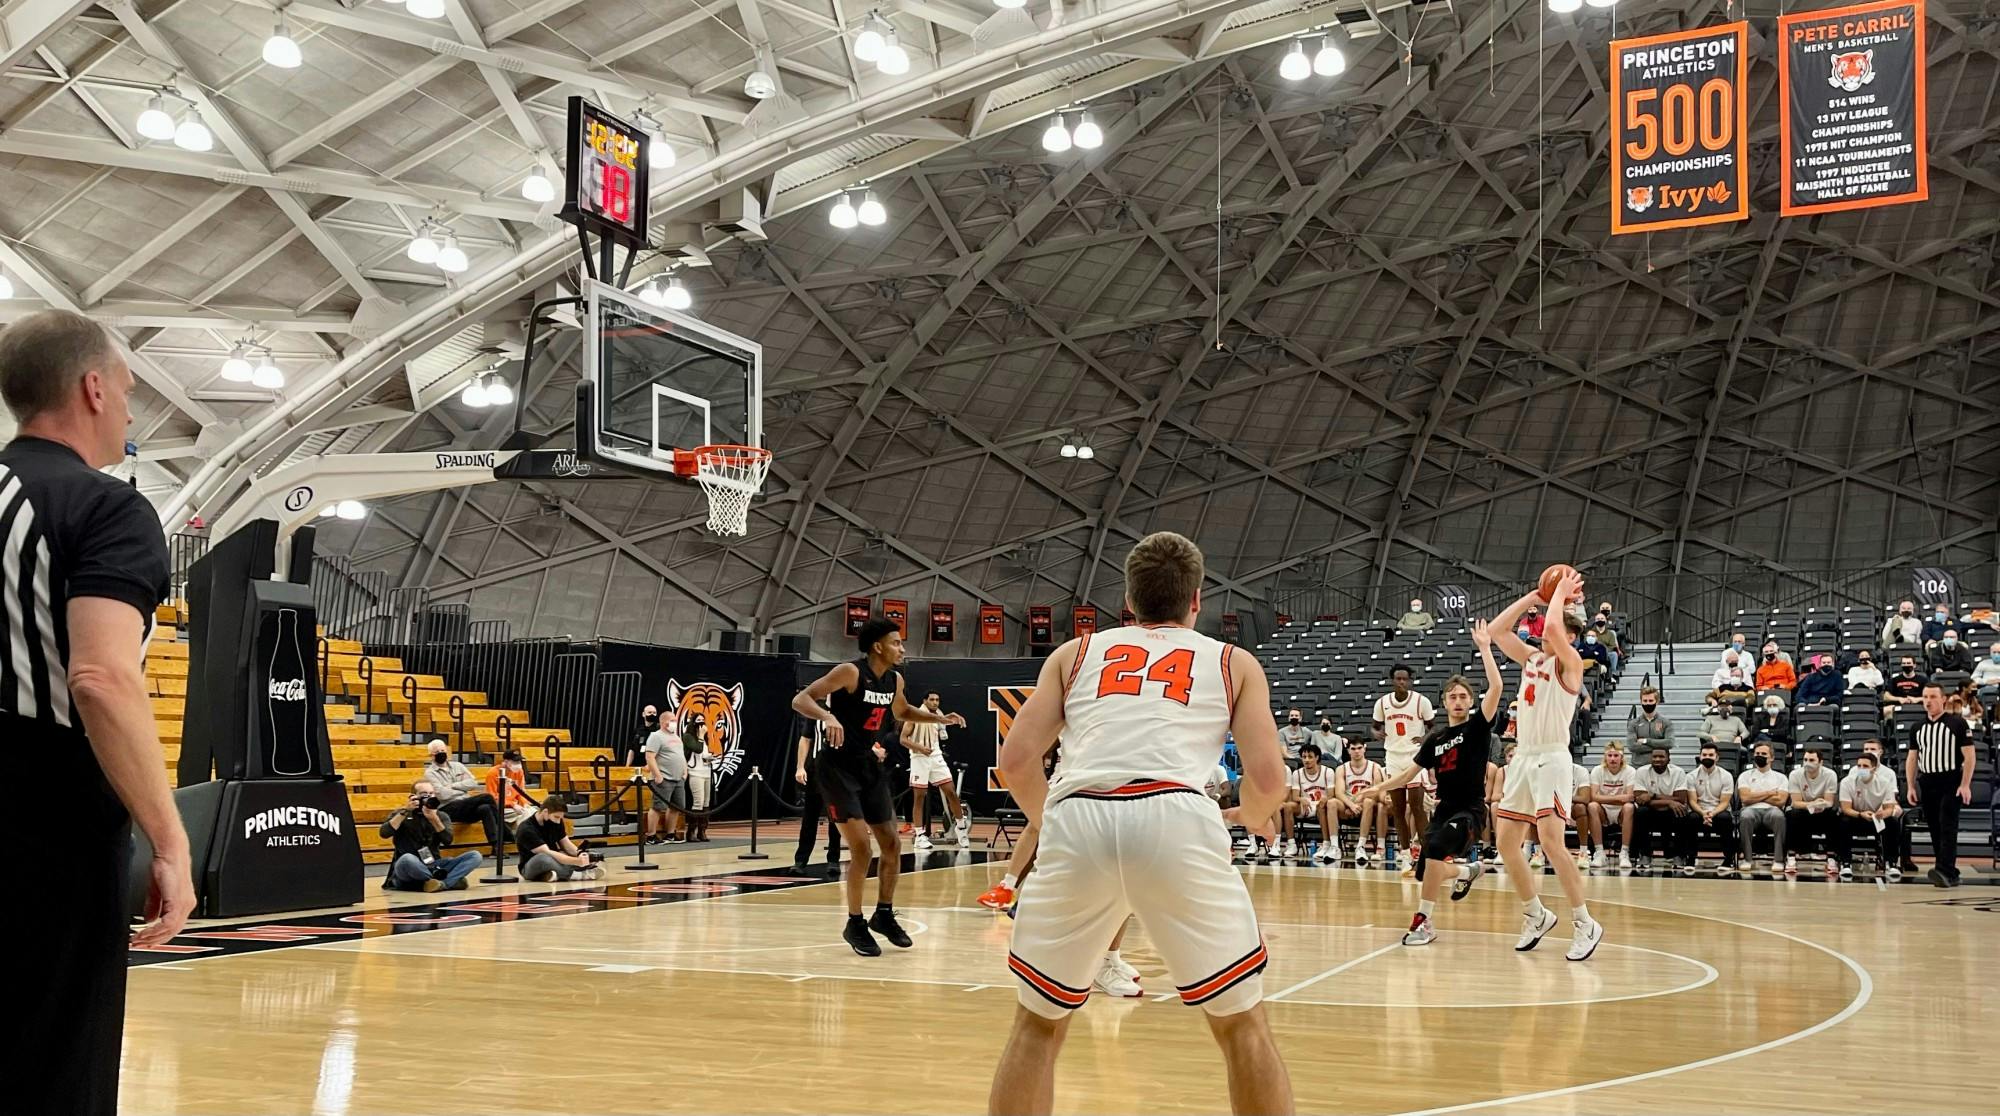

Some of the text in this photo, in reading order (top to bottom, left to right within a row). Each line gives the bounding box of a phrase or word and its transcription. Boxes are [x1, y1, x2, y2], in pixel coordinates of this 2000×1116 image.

[1793, 14, 1909, 43] PETE CARRIL
[1623, 38, 1735, 69] PRINCETON
[1804, 33, 1898, 53] MEN'S BASKETBALL
[1642, 59, 1715, 80] ATHLETICS
[1828, 94, 1876, 109] 514 WINS
[1626, 78, 1733, 161] 500
[1817, 106, 1889, 124] 13 IVY LEAGUE
[1812, 119, 1894, 138] CHAMPIONSHIPS
[1805, 132, 1902, 153] 1975 NIT CHAMPION
[1626, 153, 1733, 178] CHAMPIONSHIPS
[1795, 144, 1913, 167] 11 NCAA TOURNAMENTS
[1795, 169, 1911, 191] NAISMITH BASKETBALL
[1816, 161, 1891, 179] 1997 INDUCTEE
[1658, 185, 1706, 213] Ivy
[1817, 182, 1889, 199] HALL OF FAME
[435, 452, 495, 469] SPALDING
[1919, 579, 1948, 594] 106
[1442, 595, 1466, 609] 105
[1096, 644, 1196, 706] 24
[1524, 683, 1536, 706] 4
[244, 806, 342, 839] PRINCETON
[266, 834, 321, 847] ATHLETICS
